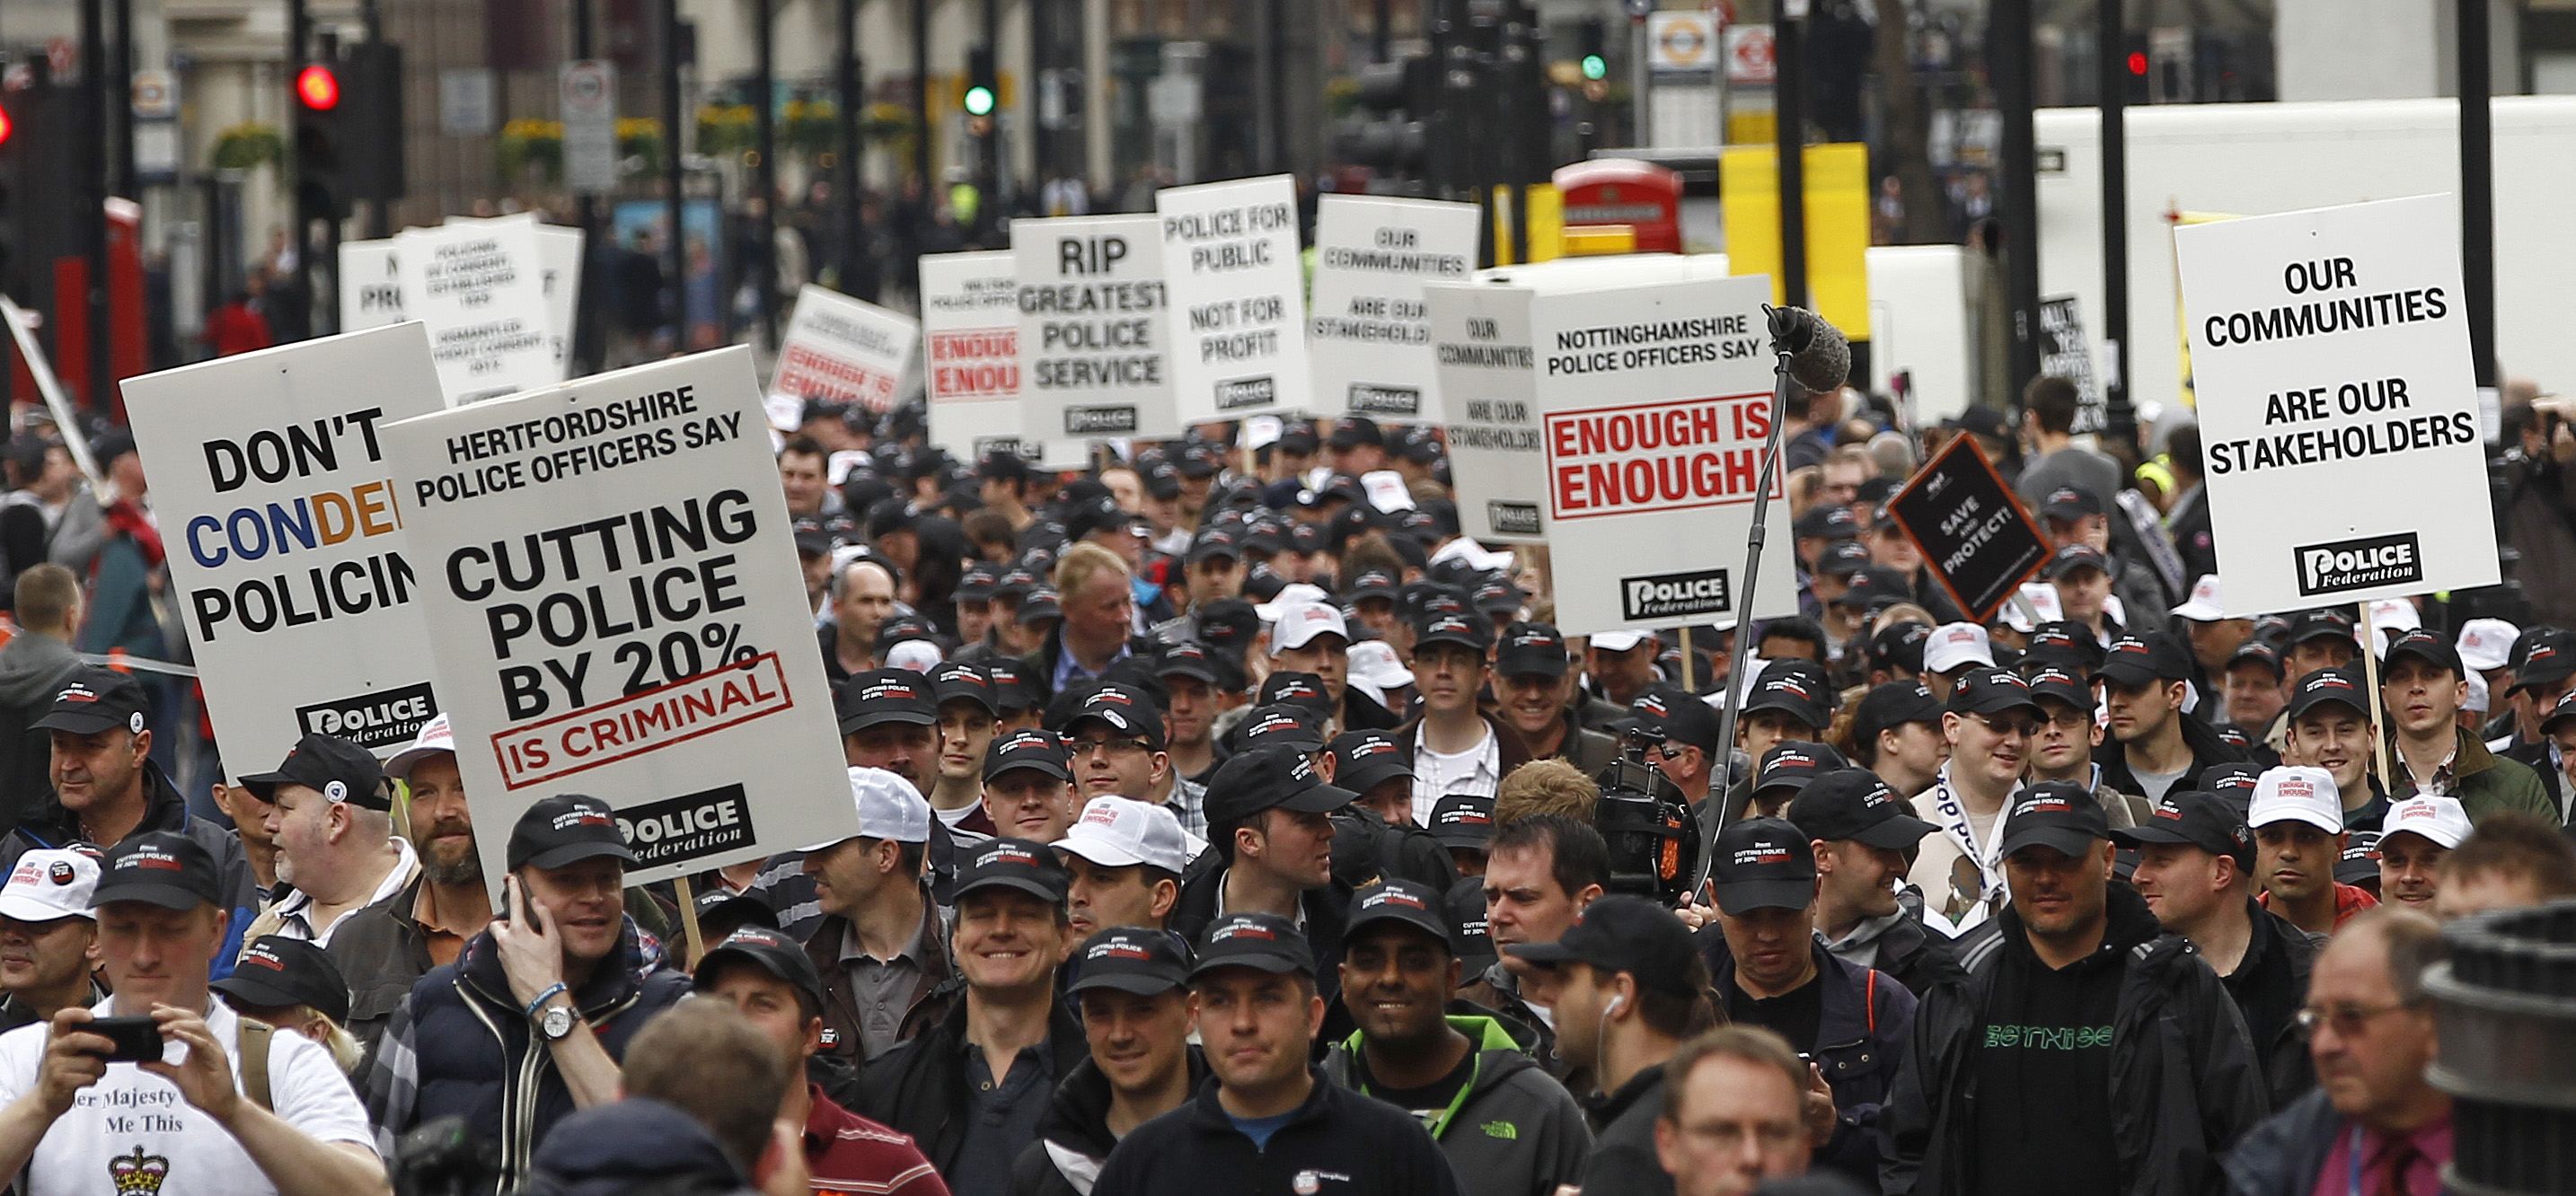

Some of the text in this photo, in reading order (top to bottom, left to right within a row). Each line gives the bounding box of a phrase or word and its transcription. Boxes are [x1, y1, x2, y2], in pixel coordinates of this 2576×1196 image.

[1164, 205, 1287, 242] POLICE FOR
[1061, 239, 1127, 275] RIP
[1193, 242, 1271, 272] PUBLIC
[2284, 257, 2358, 295] OUR
[1190, 297, 1281, 330] NOT FOR
[2205, 287, 2448, 347] COMMUNITIES
[1042, 320, 1151, 349] POLICE
[1202, 330, 1279, 363] PROFIT
[1557, 315, 1749, 351] NOTTINGHAMSHIRE
[1034, 356, 1161, 386] SERVICE
[1548, 338, 1760, 375] POLICE OFFICERS SAY
[2265, 378, 2411, 426] ARE OUR
[446, 386, 698, 464] HERTFORDSHIRE
[1554, 402, 1770, 458] ENOUGH IS
[2209, 411, 2475, 474] STAKEHOLDERS
[202, 407, 383, 493] DON'T
[415, 410, 742, 508] POLICE OFFICERS SAY
[186, 479, 402, 567] CONDE
[1940, 495, 1981, 536] SAVE
[446, 489, 757, 602] CUTTING
[1942, 506, 2013, 575] PROTECT!
[2303, 543, 2413, 590] POLICE
[2322, 567, 2413, 587] Federation
[486, 554, 746, 661] POLICE
[1628, 578, 1723, 615] POLICE
[1644, 598, 1725, 614] Federation
[498, 623, 759, 721] BY 20%
[306, 695, 429, 735] POLICE
[333, 718, 430, 744] deratio
[507, 674, 777, 774] IS CRIMINAL
[583, 810, 606, 818] POLICE
[146, 852, 174, 863] POLICE
[628, 829, 743, 862] ederation
[1762, 848, 1786, 856] POLICE
[75, 1086, 176, 1109] er Majesty
[104, 1114, 183, 1134] Me This
